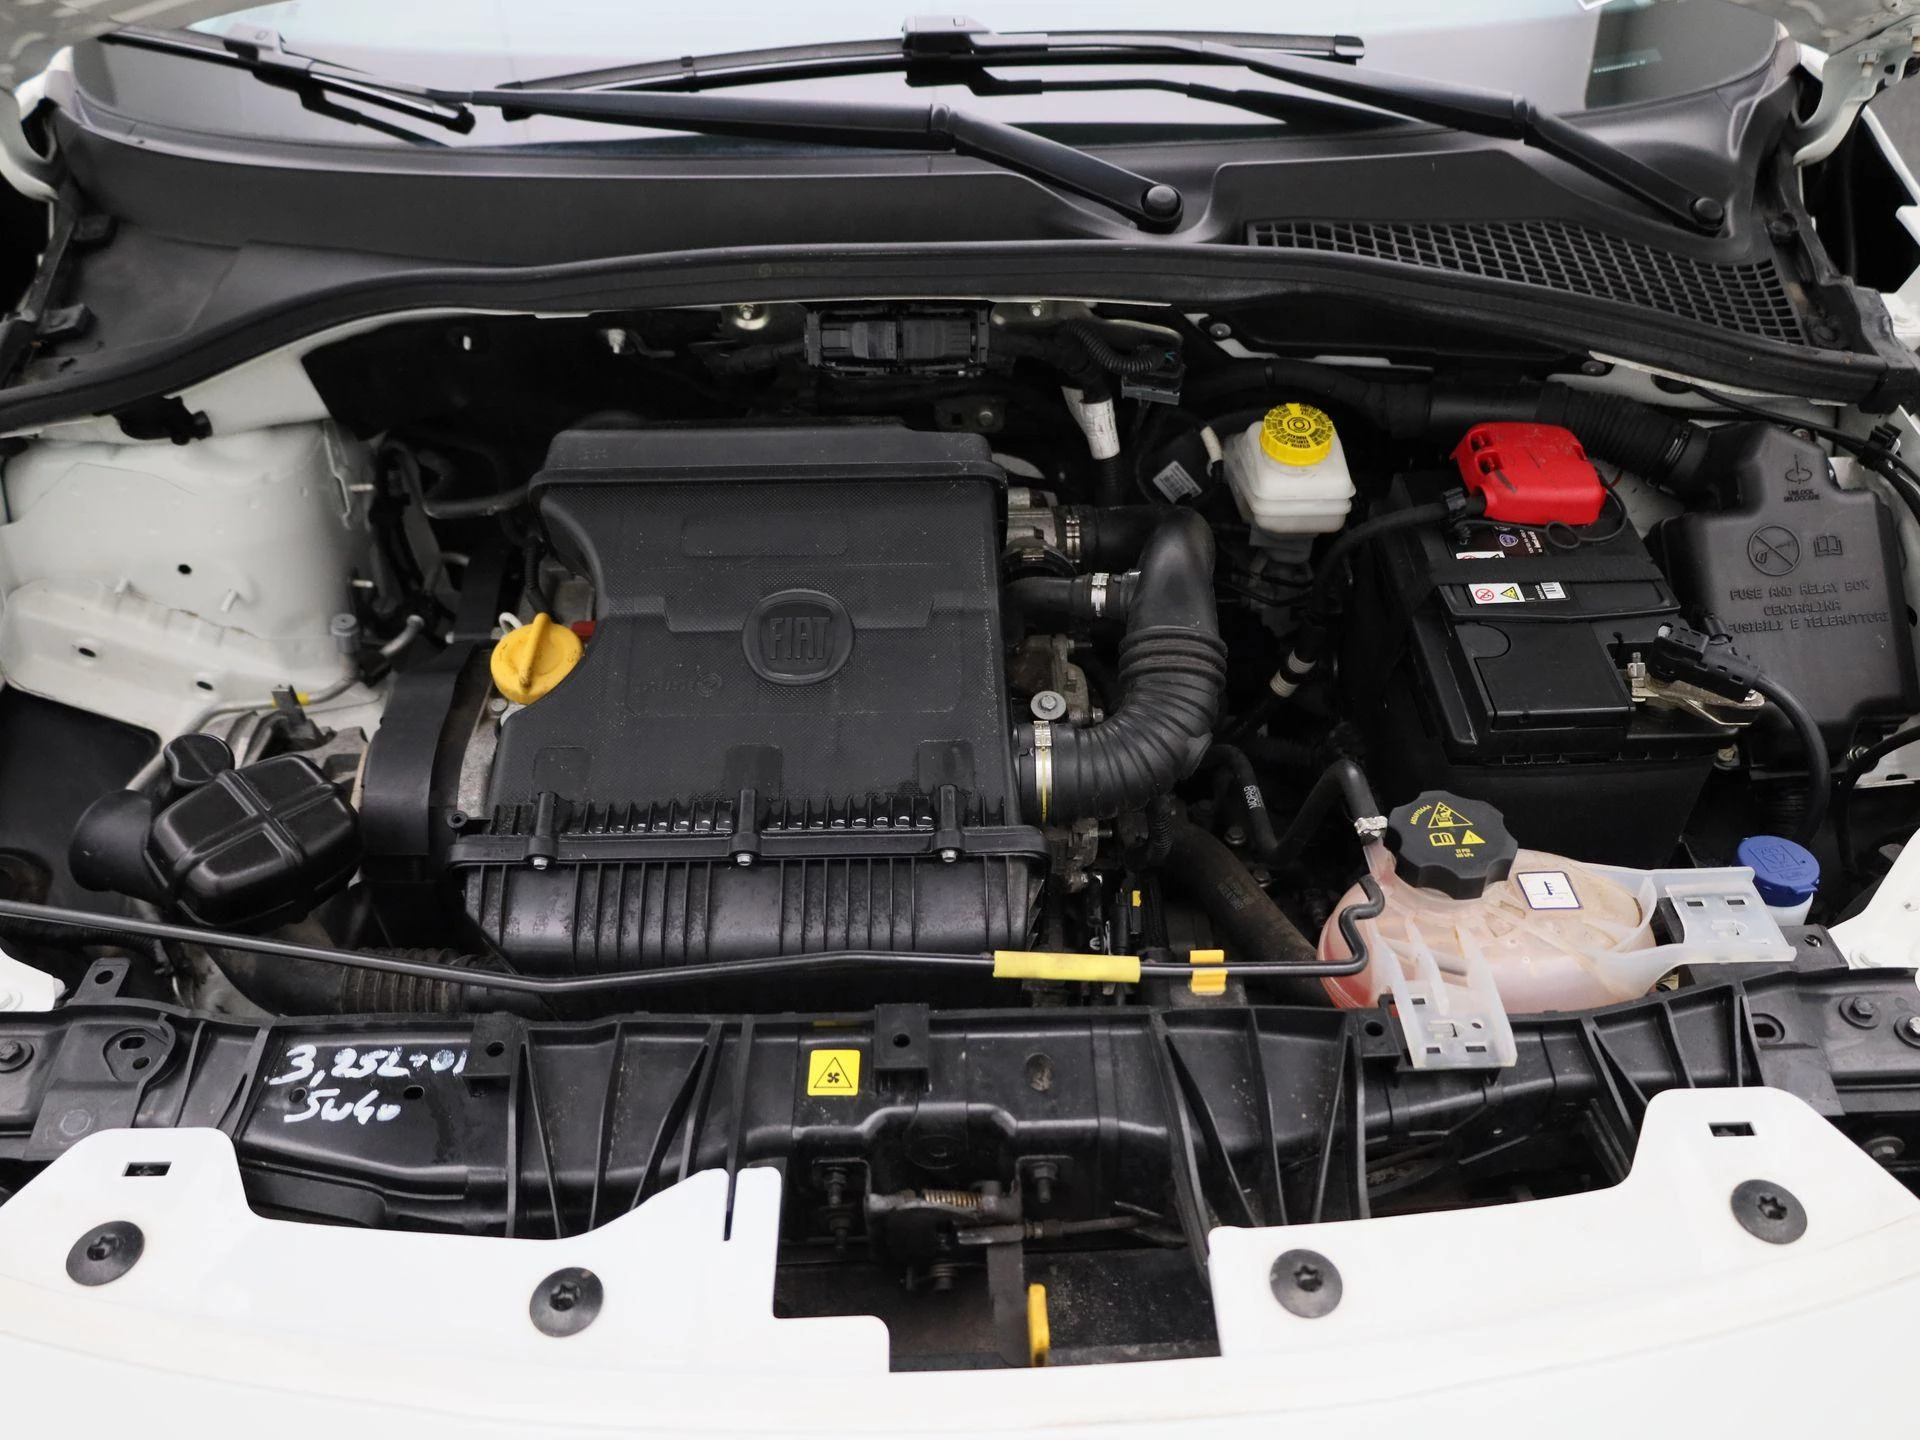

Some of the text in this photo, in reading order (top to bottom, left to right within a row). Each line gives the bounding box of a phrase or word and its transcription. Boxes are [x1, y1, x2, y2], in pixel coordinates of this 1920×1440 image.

[1730, 579, 1871, 600] FUSE AND RELAY BOX
[1763, 600, 1841, 616] CENTRALINA
[1790, 619, 1799, 629] E
[1804, 611, 1890, 628] TELERUTTORI
[769, 616, 831, 660] FIAT
